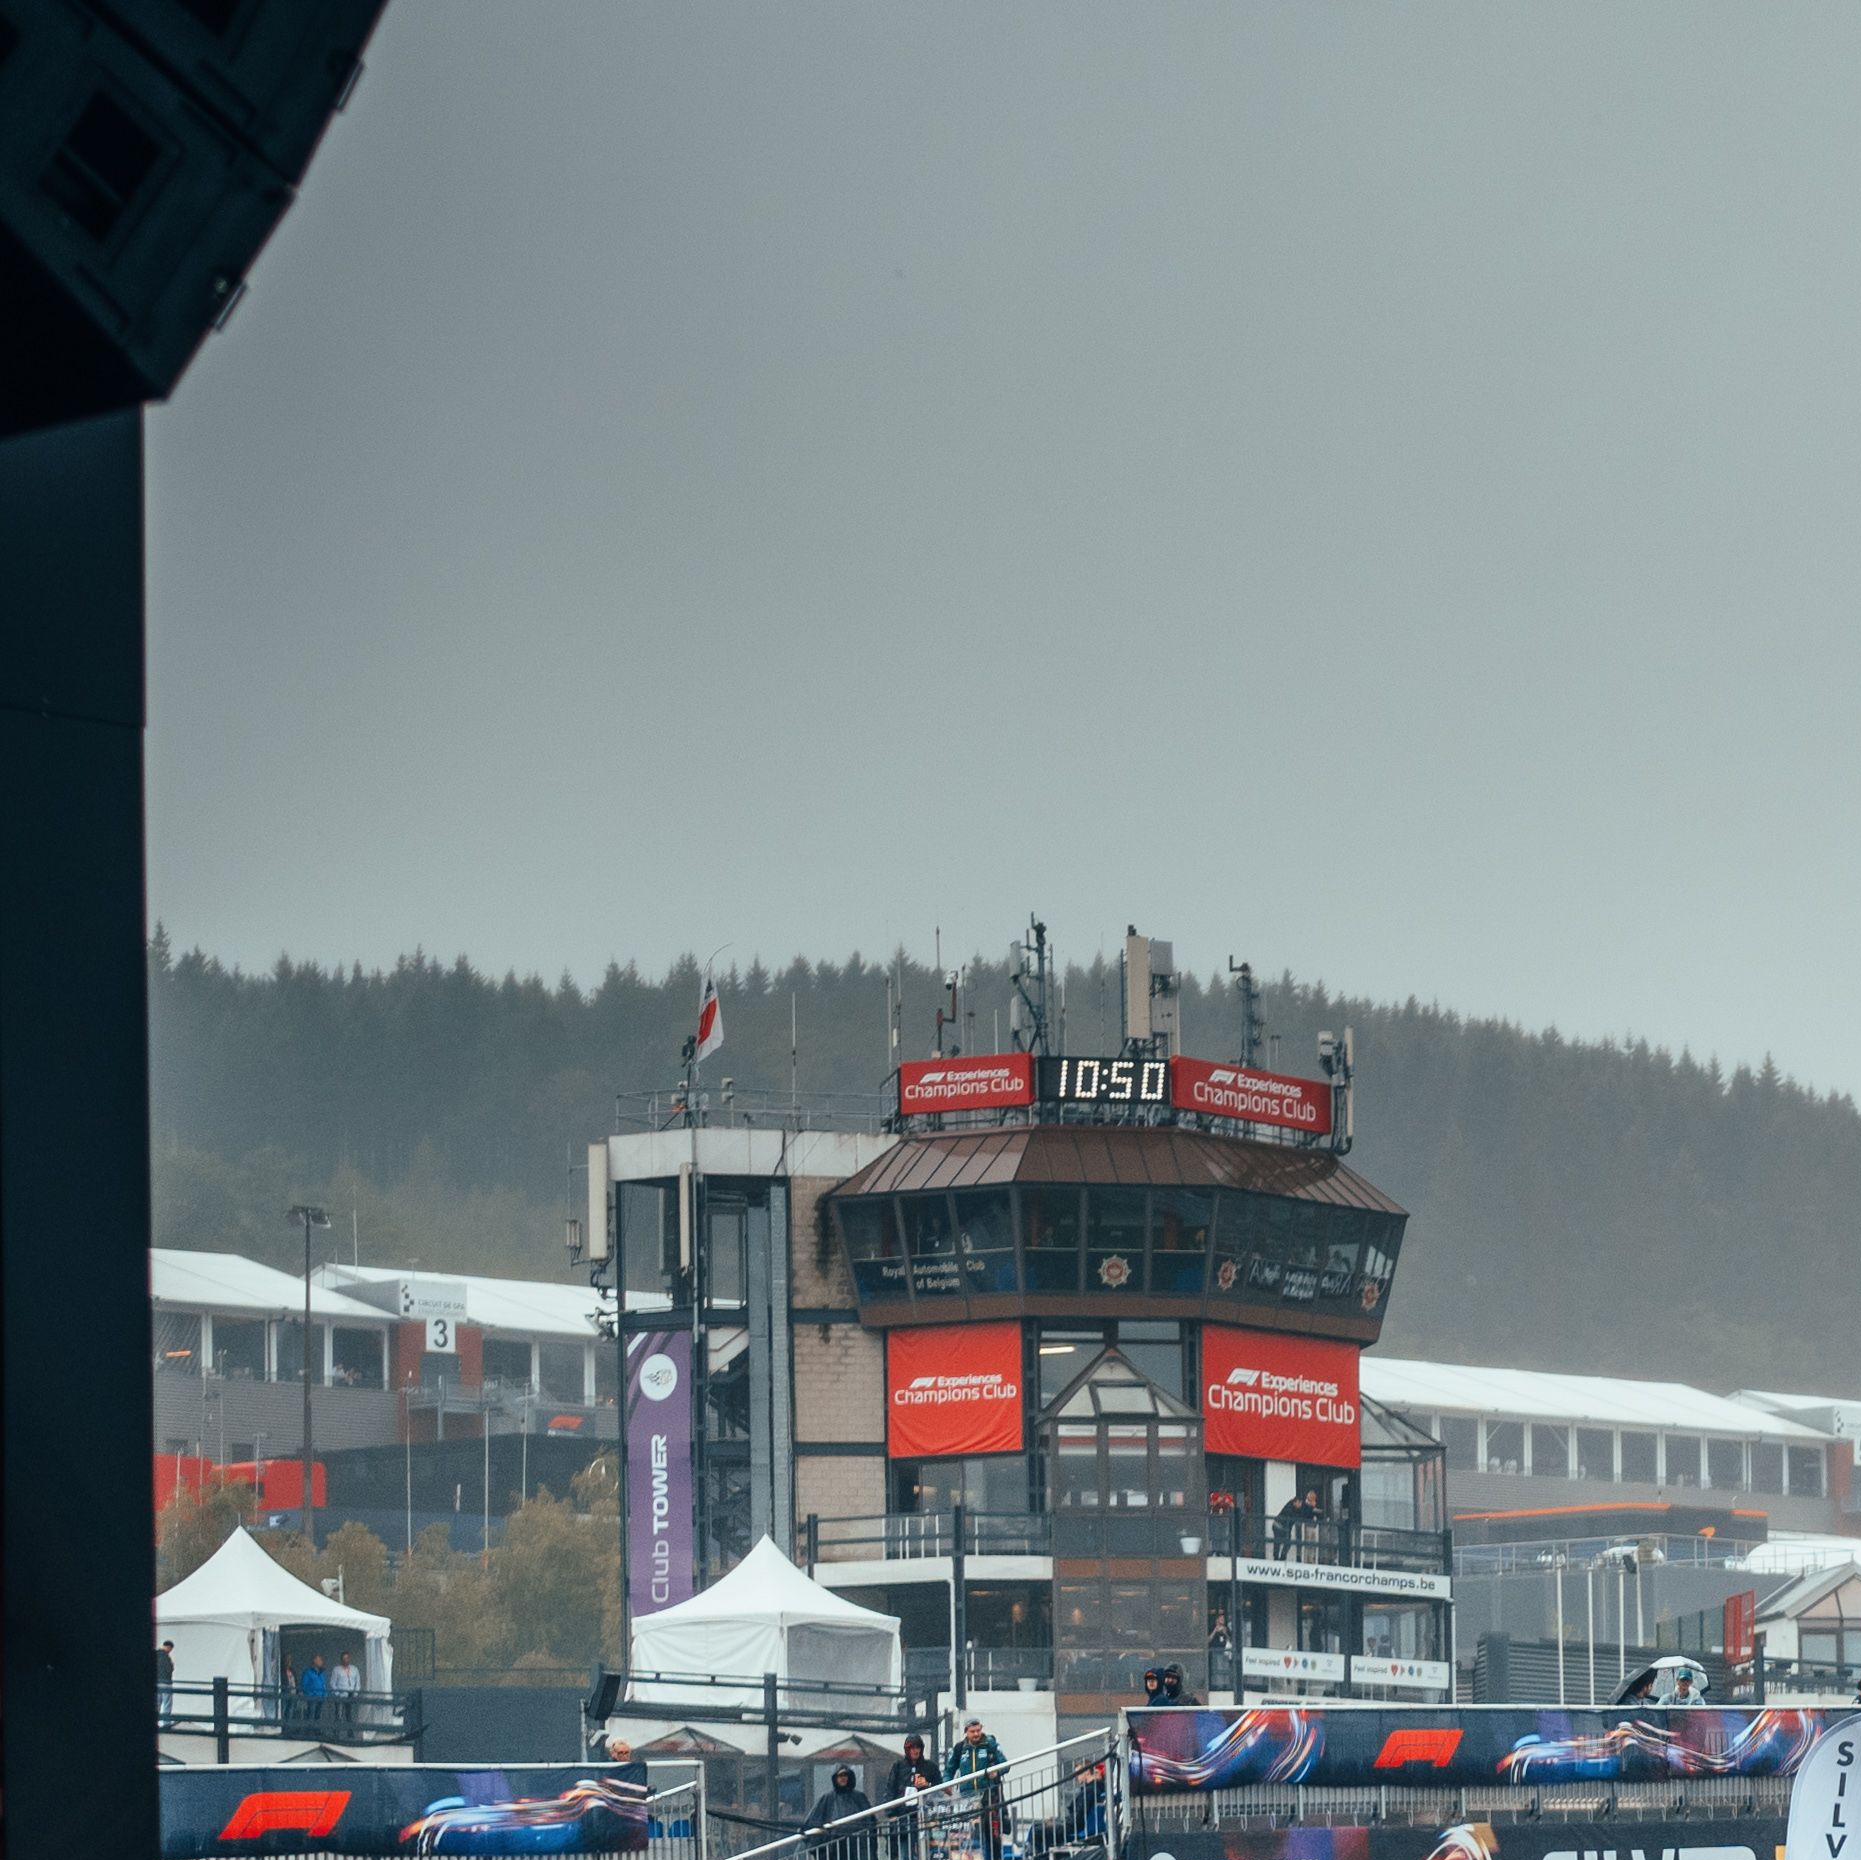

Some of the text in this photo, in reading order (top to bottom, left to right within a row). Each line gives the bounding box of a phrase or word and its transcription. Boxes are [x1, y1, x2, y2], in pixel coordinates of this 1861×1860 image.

[946, 1067, 1010, 1081] Experiences
[1059, 1060, 1165, 1100] 10:50
[905, 1078, 1024, 1099] Champions Club
[1238, 1073, 1302, 1098] Experiences
[1194, 1082, 1316, 1121] Champions Club
[882, 1261, 985, 1279] Royal Automobile Club
[926, 1277, 960, 1289] Belgium
[433, 1318, 448, 1348] 3
[937, 1374, 1001, 1387] Experiences
[1261, 1372, 1338, 1396] Experiences
[895, 1384, 1017, 1405] Champions Club
[1208, 1384, 1355, 1425] Champions Club
[651, 1434, 669, 1603] Club TOWER
[1247, 1563, 1435, 1591] www.spa-francorchamps.be
[1245, 1655, 1281, 1667] Feel inspired
[1353, 1663, 1388, 1675] Feel inspired
